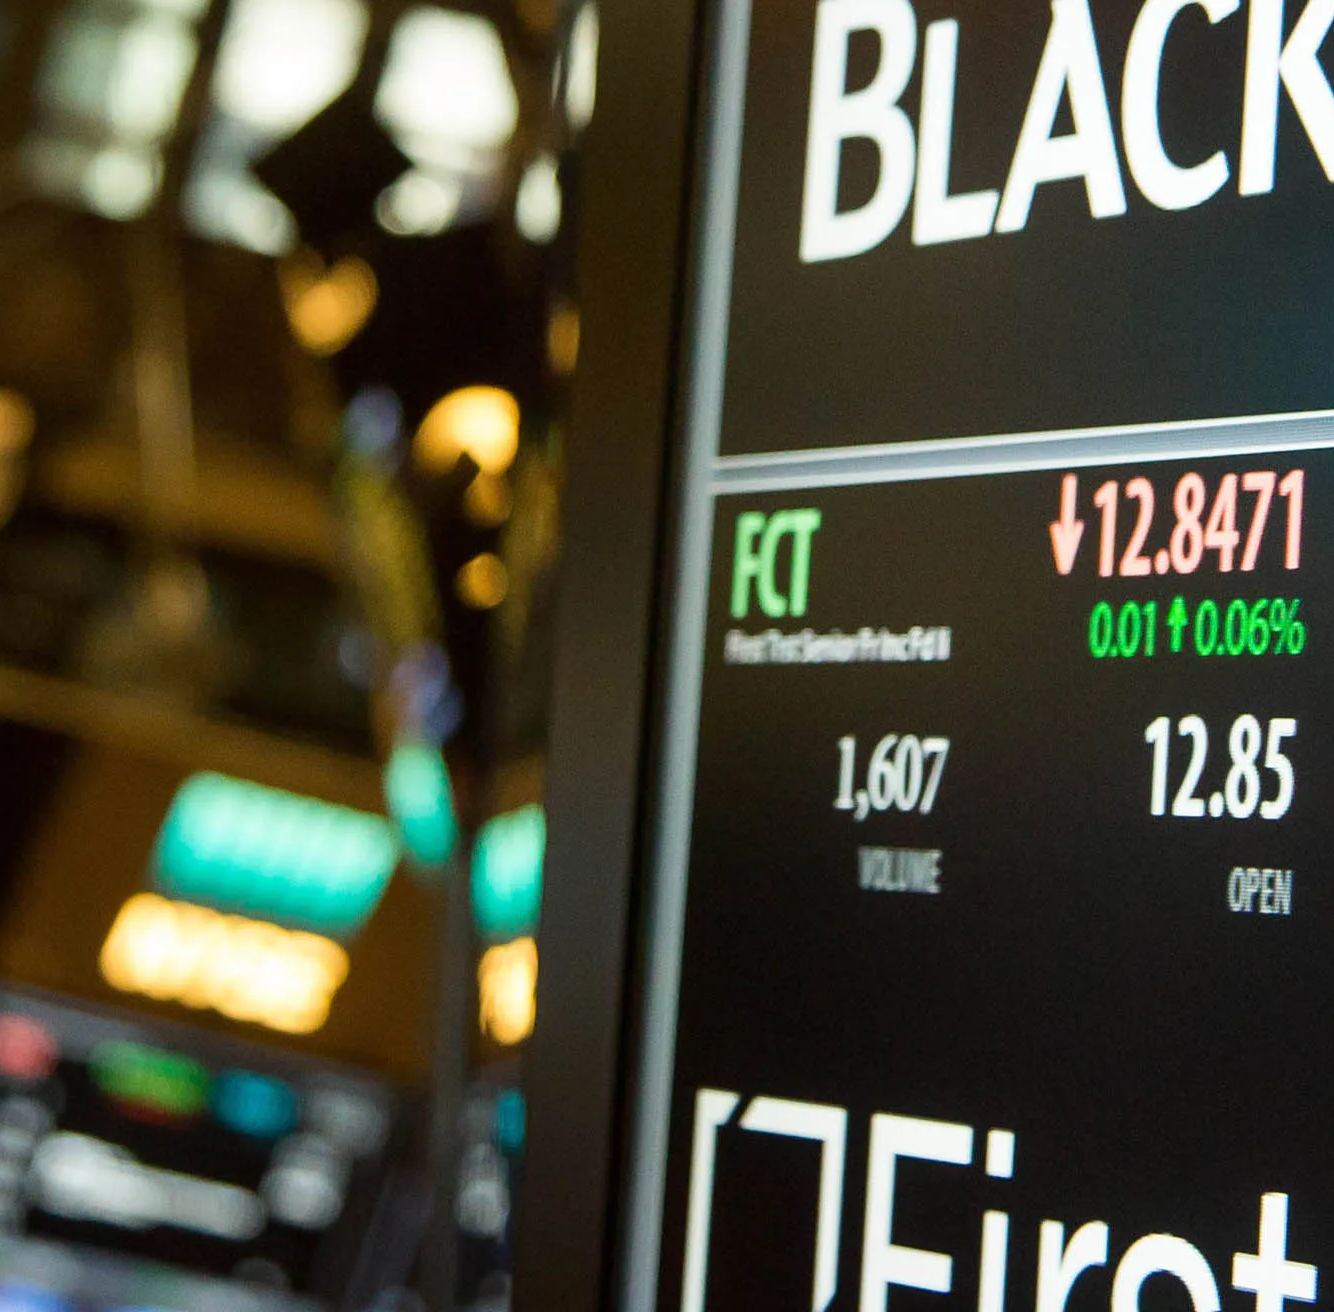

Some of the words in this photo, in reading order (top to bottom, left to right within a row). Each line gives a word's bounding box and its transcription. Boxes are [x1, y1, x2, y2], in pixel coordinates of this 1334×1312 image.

[730, 508, 822, 618] FCT
[1093, 468, 1306, 578] 12.8471
[1089, 600, 1156, 658] 0.01
[1193, 598, 1306, 657] 0.06%
[832, 734, 950, 821] 1,607
[1144, 713, 1297, 820] 12.85
[1227, 866, 1293, 916] OPEN
